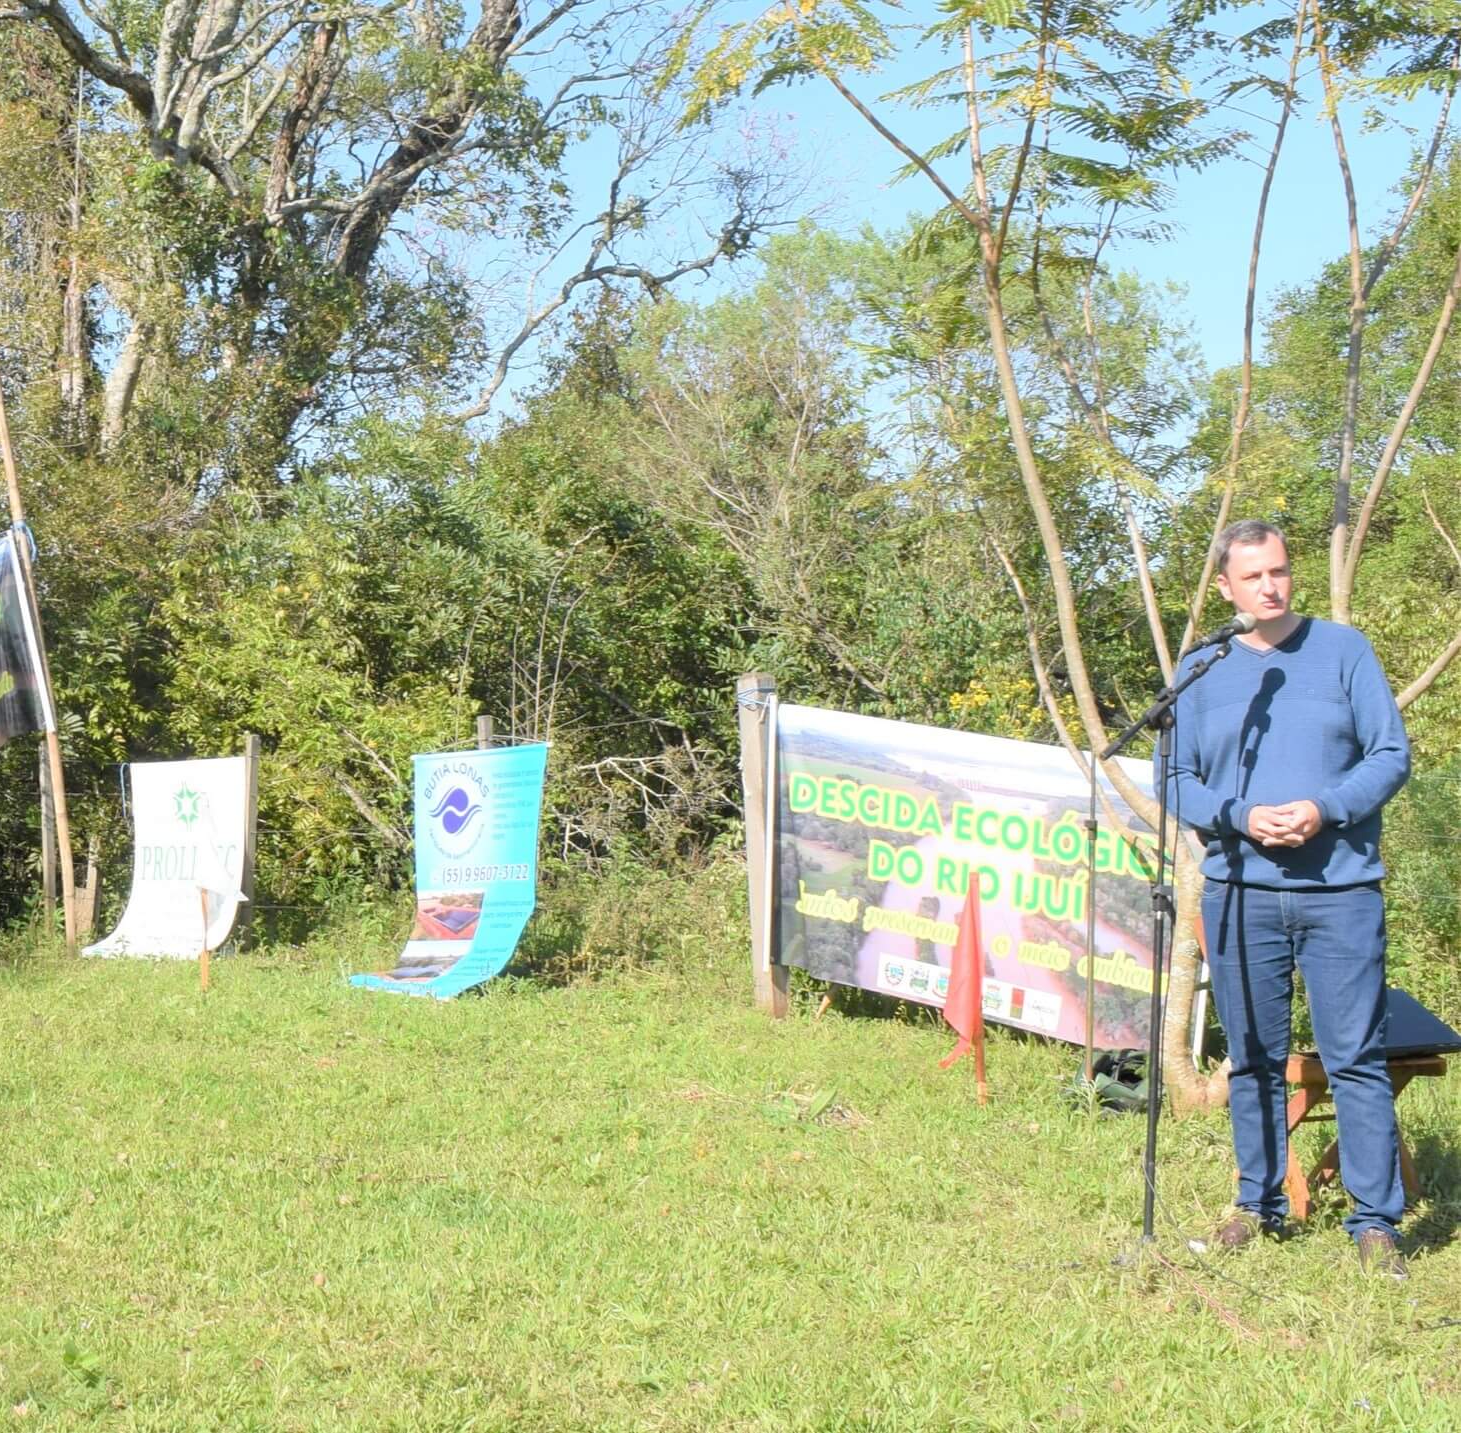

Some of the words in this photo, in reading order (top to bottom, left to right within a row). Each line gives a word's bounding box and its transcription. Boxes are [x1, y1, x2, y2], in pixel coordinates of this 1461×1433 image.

[452, 762, 489, 798] LONAS
[790, 772, 943, 837] DESCIDA
[140, 844, 237, 881] PROLIC
[442, 867, 463, 886] (55)
[465, 867, 472, 883] 9
[473, 863, 529, 882] 9607-3122
[869, 839, 924, 887] DO
[936, 855, 1000, 902] RIO
[1012, 870, 1087, 923] IJUÍ
[992, 933, 1011, 957] o
[1018, 941, 1071, 972] meio
